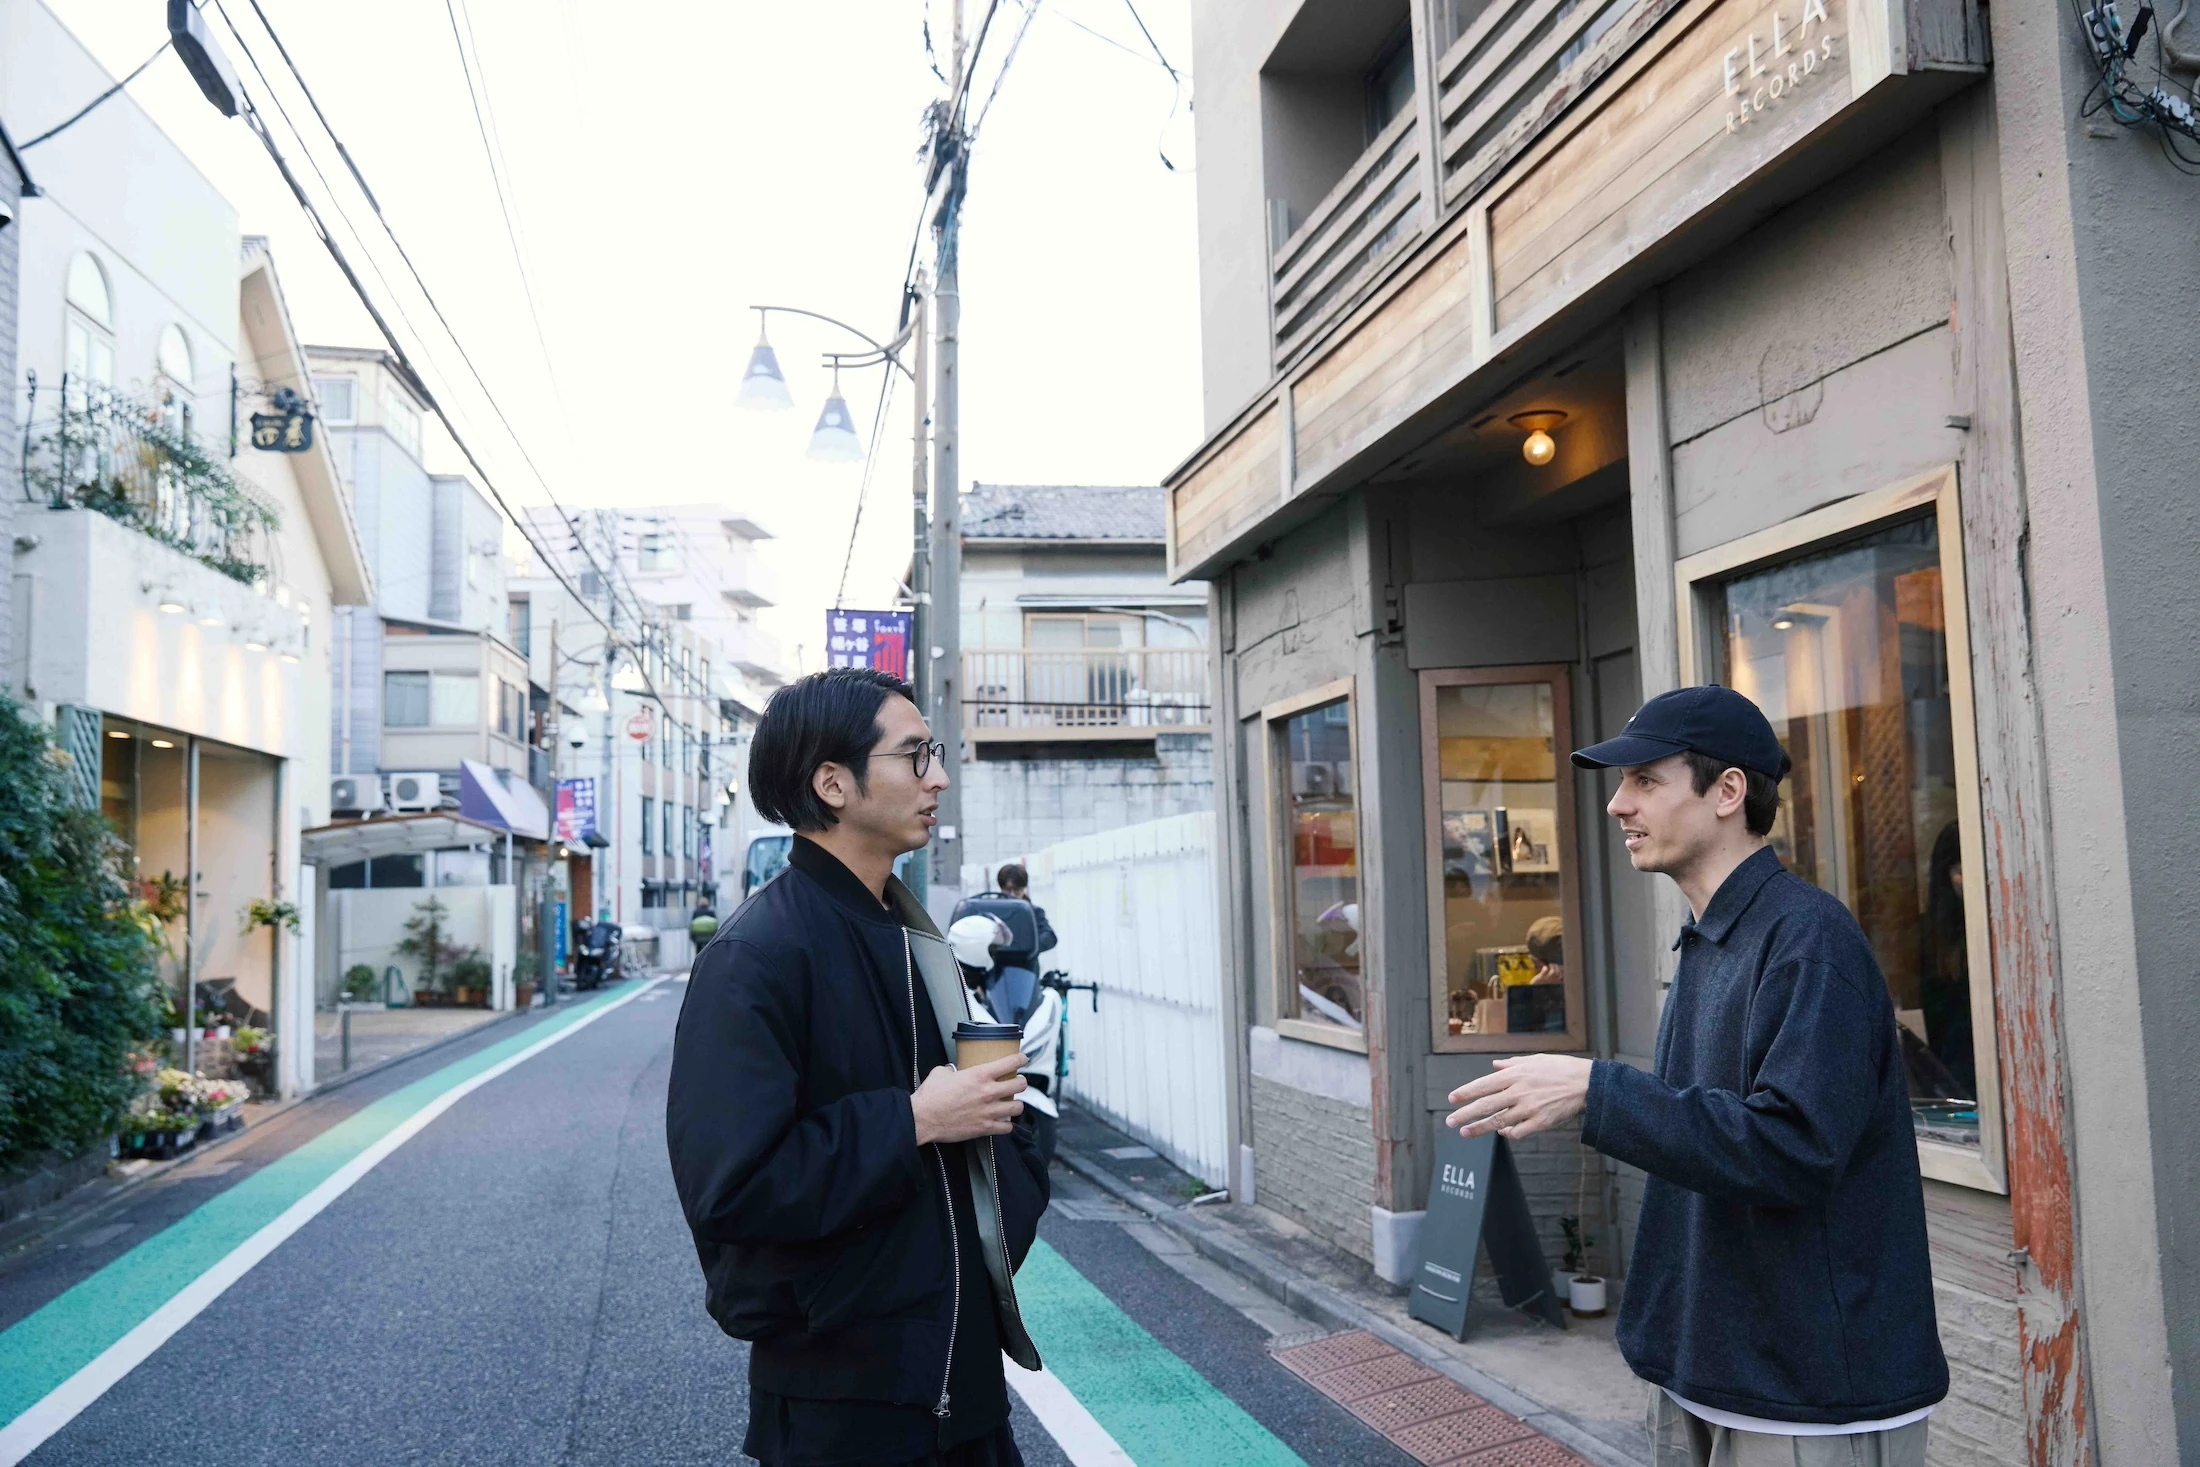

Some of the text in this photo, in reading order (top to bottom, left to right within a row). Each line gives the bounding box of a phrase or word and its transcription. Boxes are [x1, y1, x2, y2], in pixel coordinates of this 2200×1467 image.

[1723, 0, 1828, 98] ELLA
[1725, 34, 1832, 135] RECORDS
[1441, 1184, 1474, 1200] RECORDS
[1442, 1163, 1475, 1190] ELLA
